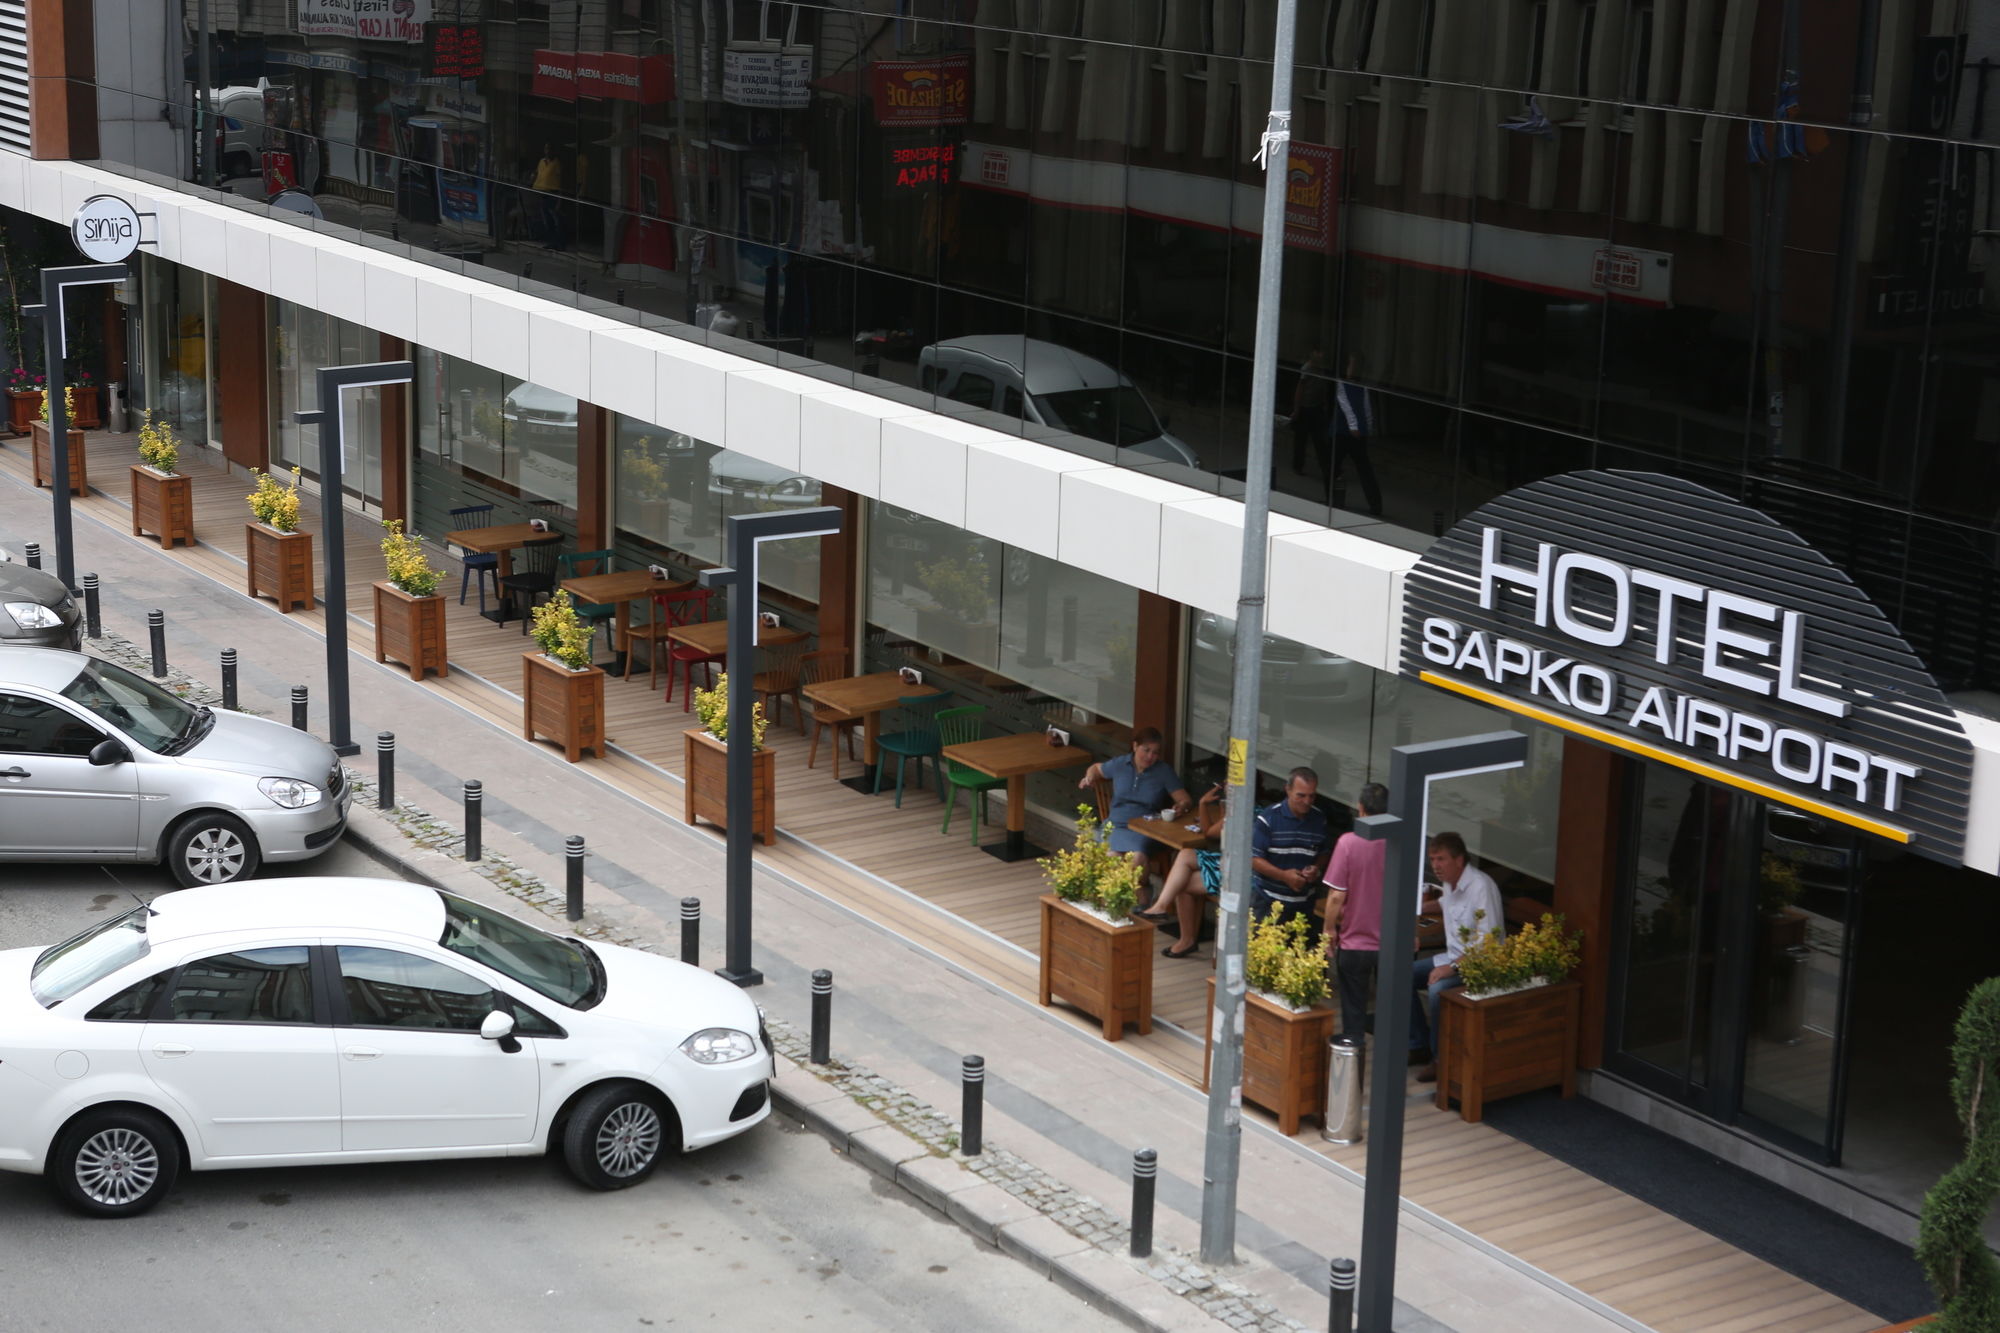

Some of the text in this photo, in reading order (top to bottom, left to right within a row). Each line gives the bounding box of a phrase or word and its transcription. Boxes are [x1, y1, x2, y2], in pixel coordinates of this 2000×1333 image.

[1422, 618, 1922, 812] SAPKO AIRPORT
[1480, 527, 1851, 718] HOTEL
